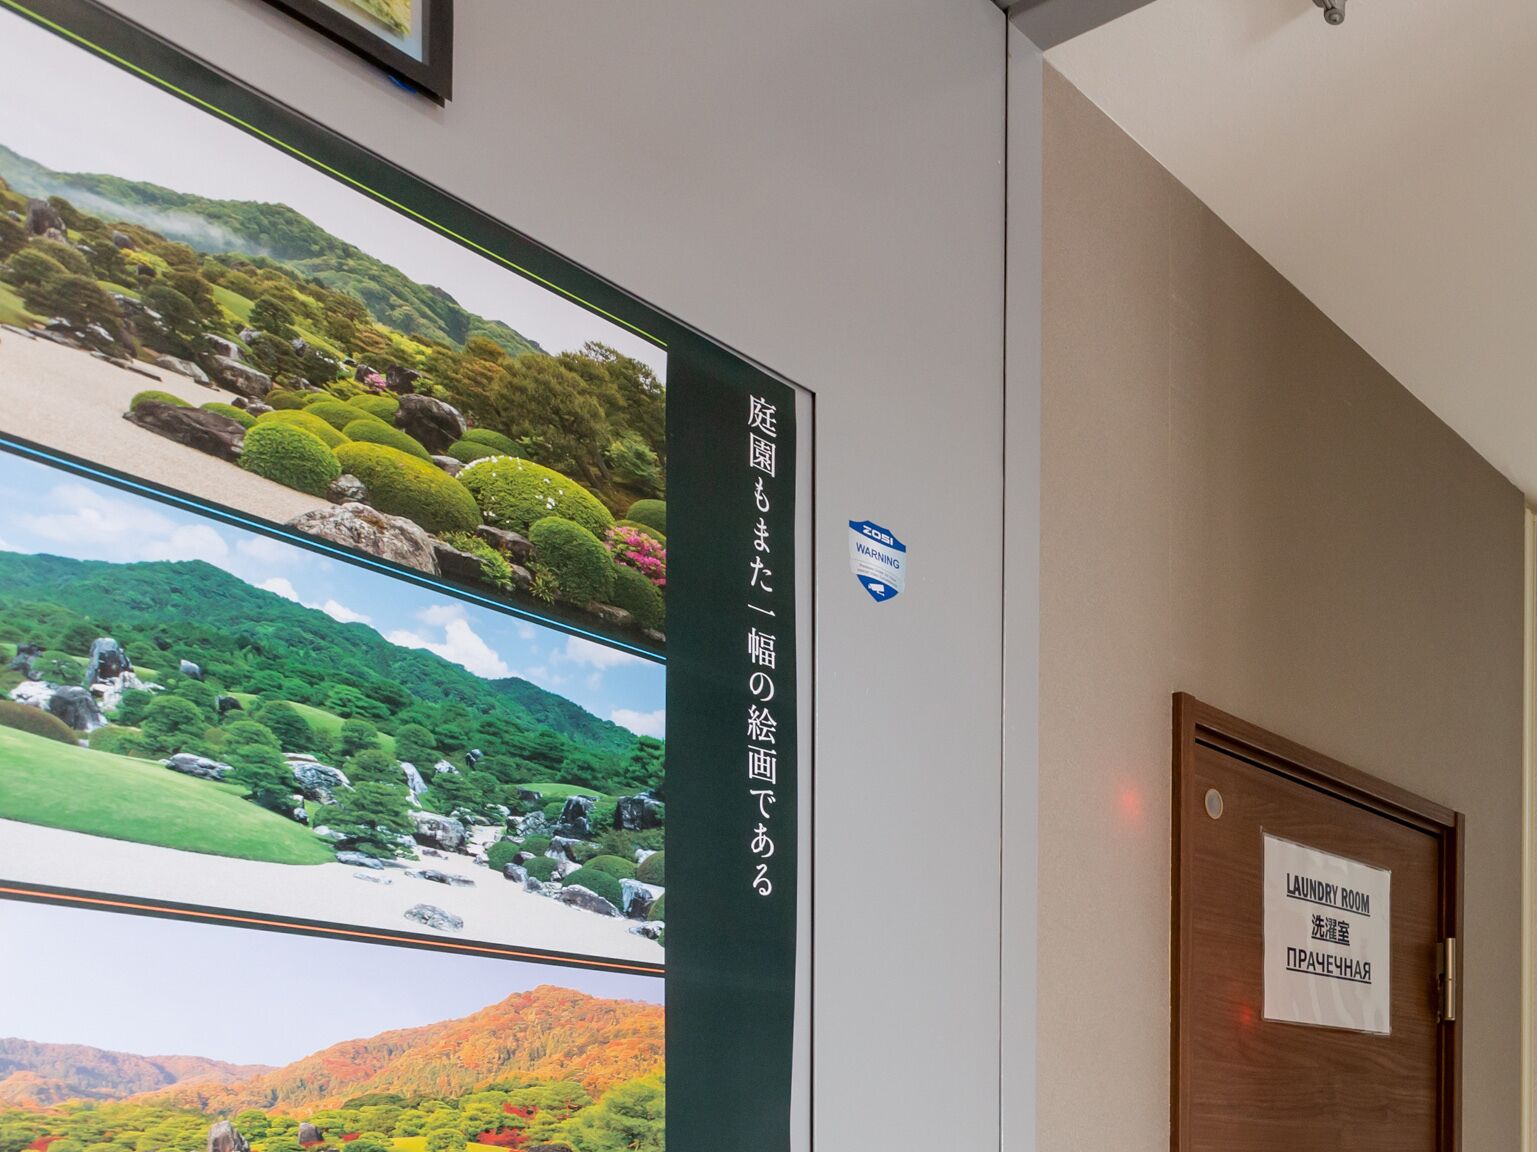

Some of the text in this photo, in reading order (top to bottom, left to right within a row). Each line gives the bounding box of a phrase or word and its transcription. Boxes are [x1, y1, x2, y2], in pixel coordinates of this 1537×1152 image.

[862, 525, 894, 546] ZOSI
[856, 541, 900, 570] WARNING
[747, 394, 777, 897] 庭園もまた一幅の絵画である
[1286, 872, 1370, 914] LAUNDRY ROOM
[1311, 913, 1350, 944] 洗濯室
[1286, 946, 1371, 981] ПРАЧЕЧНАЯ
